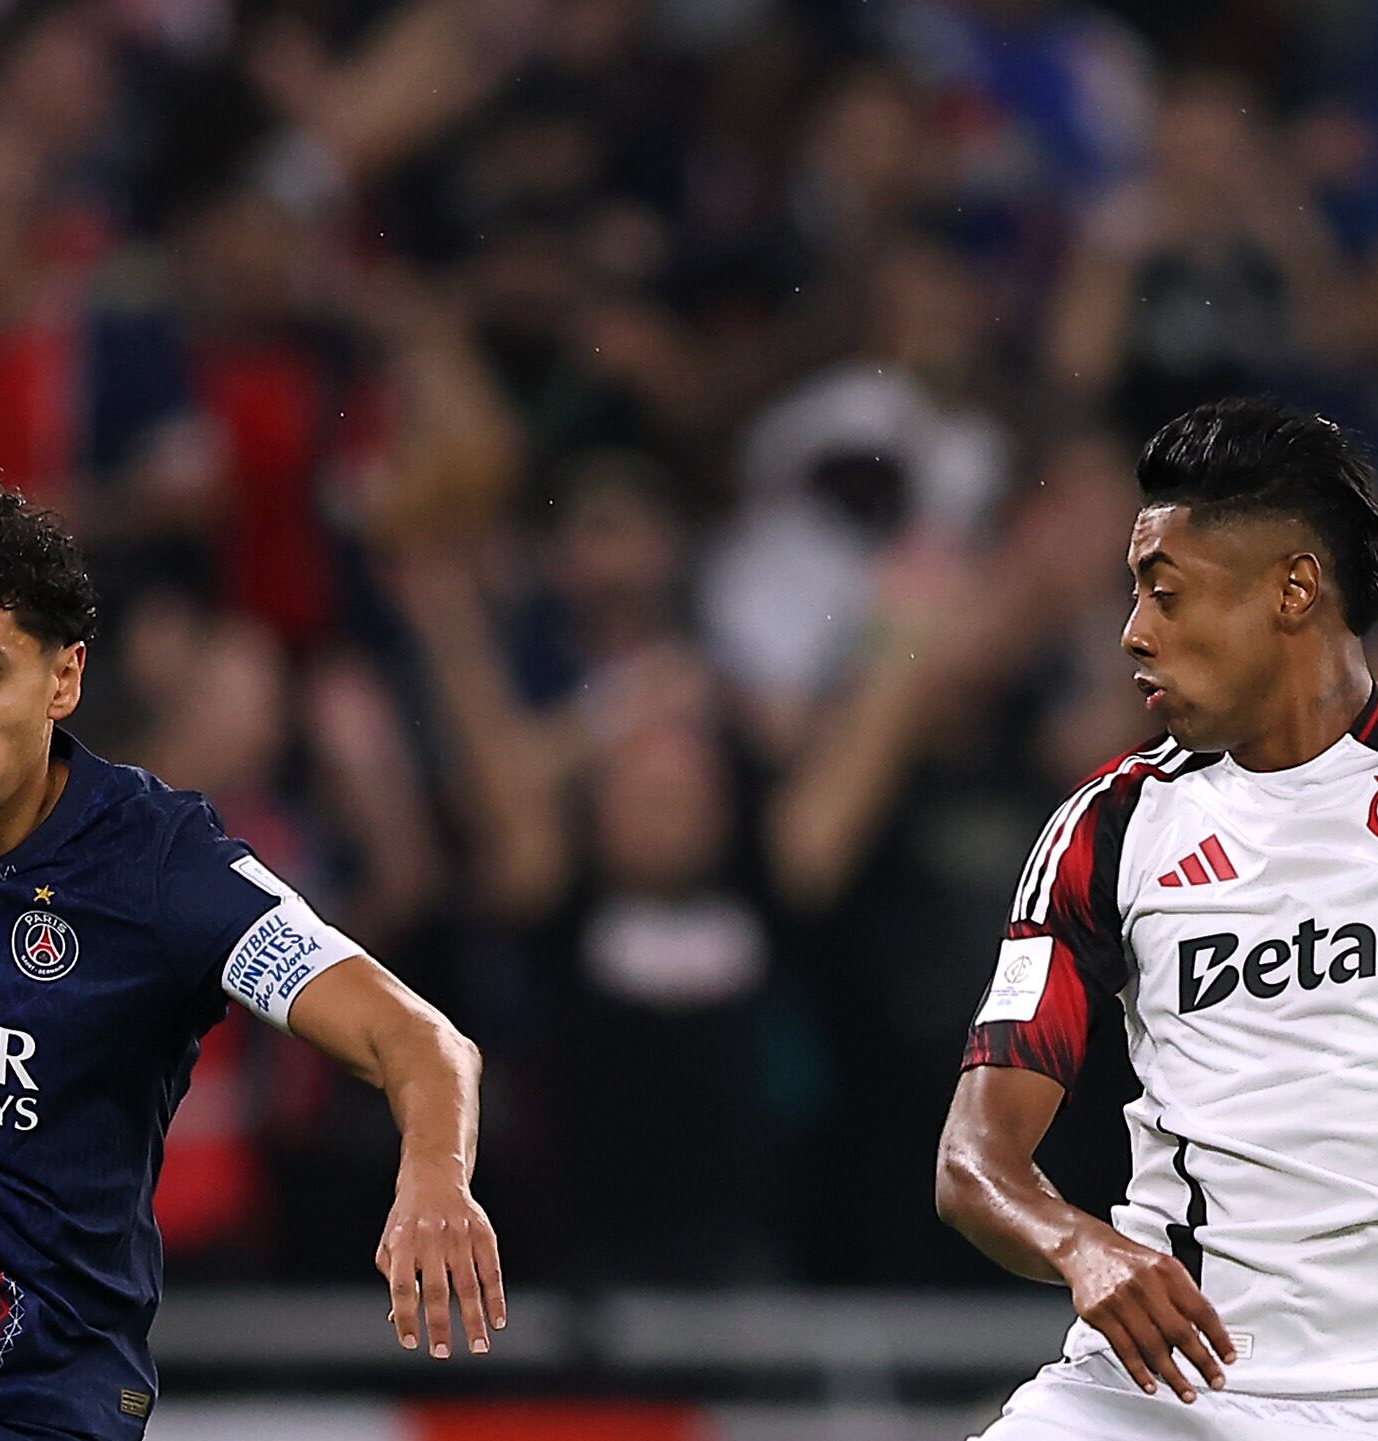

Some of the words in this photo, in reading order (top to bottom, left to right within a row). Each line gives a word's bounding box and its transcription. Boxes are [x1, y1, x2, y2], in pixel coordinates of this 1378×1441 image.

[24, 914, 68, 934] PARIS
[226, 914, 288, 989] FOOTBALL
[238, 927, 304, 999] UNITES
[255, 982, 274, 1013] the
[267, 936, 322, 982] World
[280, 965, 312, 998] FIFA
